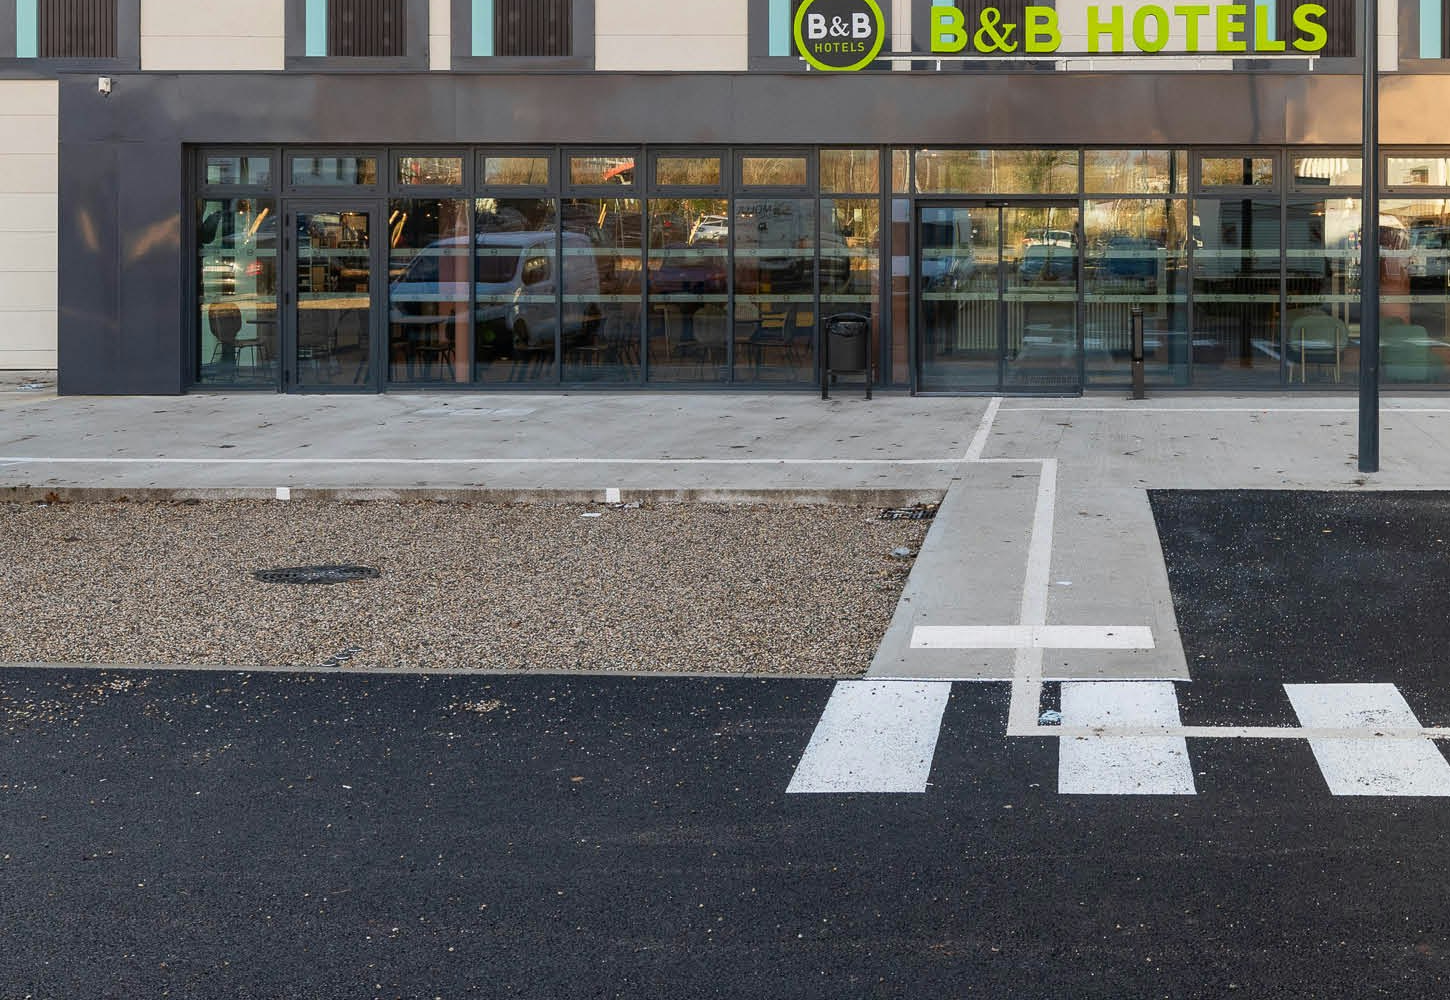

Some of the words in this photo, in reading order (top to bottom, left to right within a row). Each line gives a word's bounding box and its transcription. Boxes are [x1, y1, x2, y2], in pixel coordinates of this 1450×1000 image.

[807, 12, 872, 39] B&B
[930, 6, 1062, 53] B&B
[1087, 4, 1328, 53] HOTELS
[814, 41, 865, 53] HOTELS
